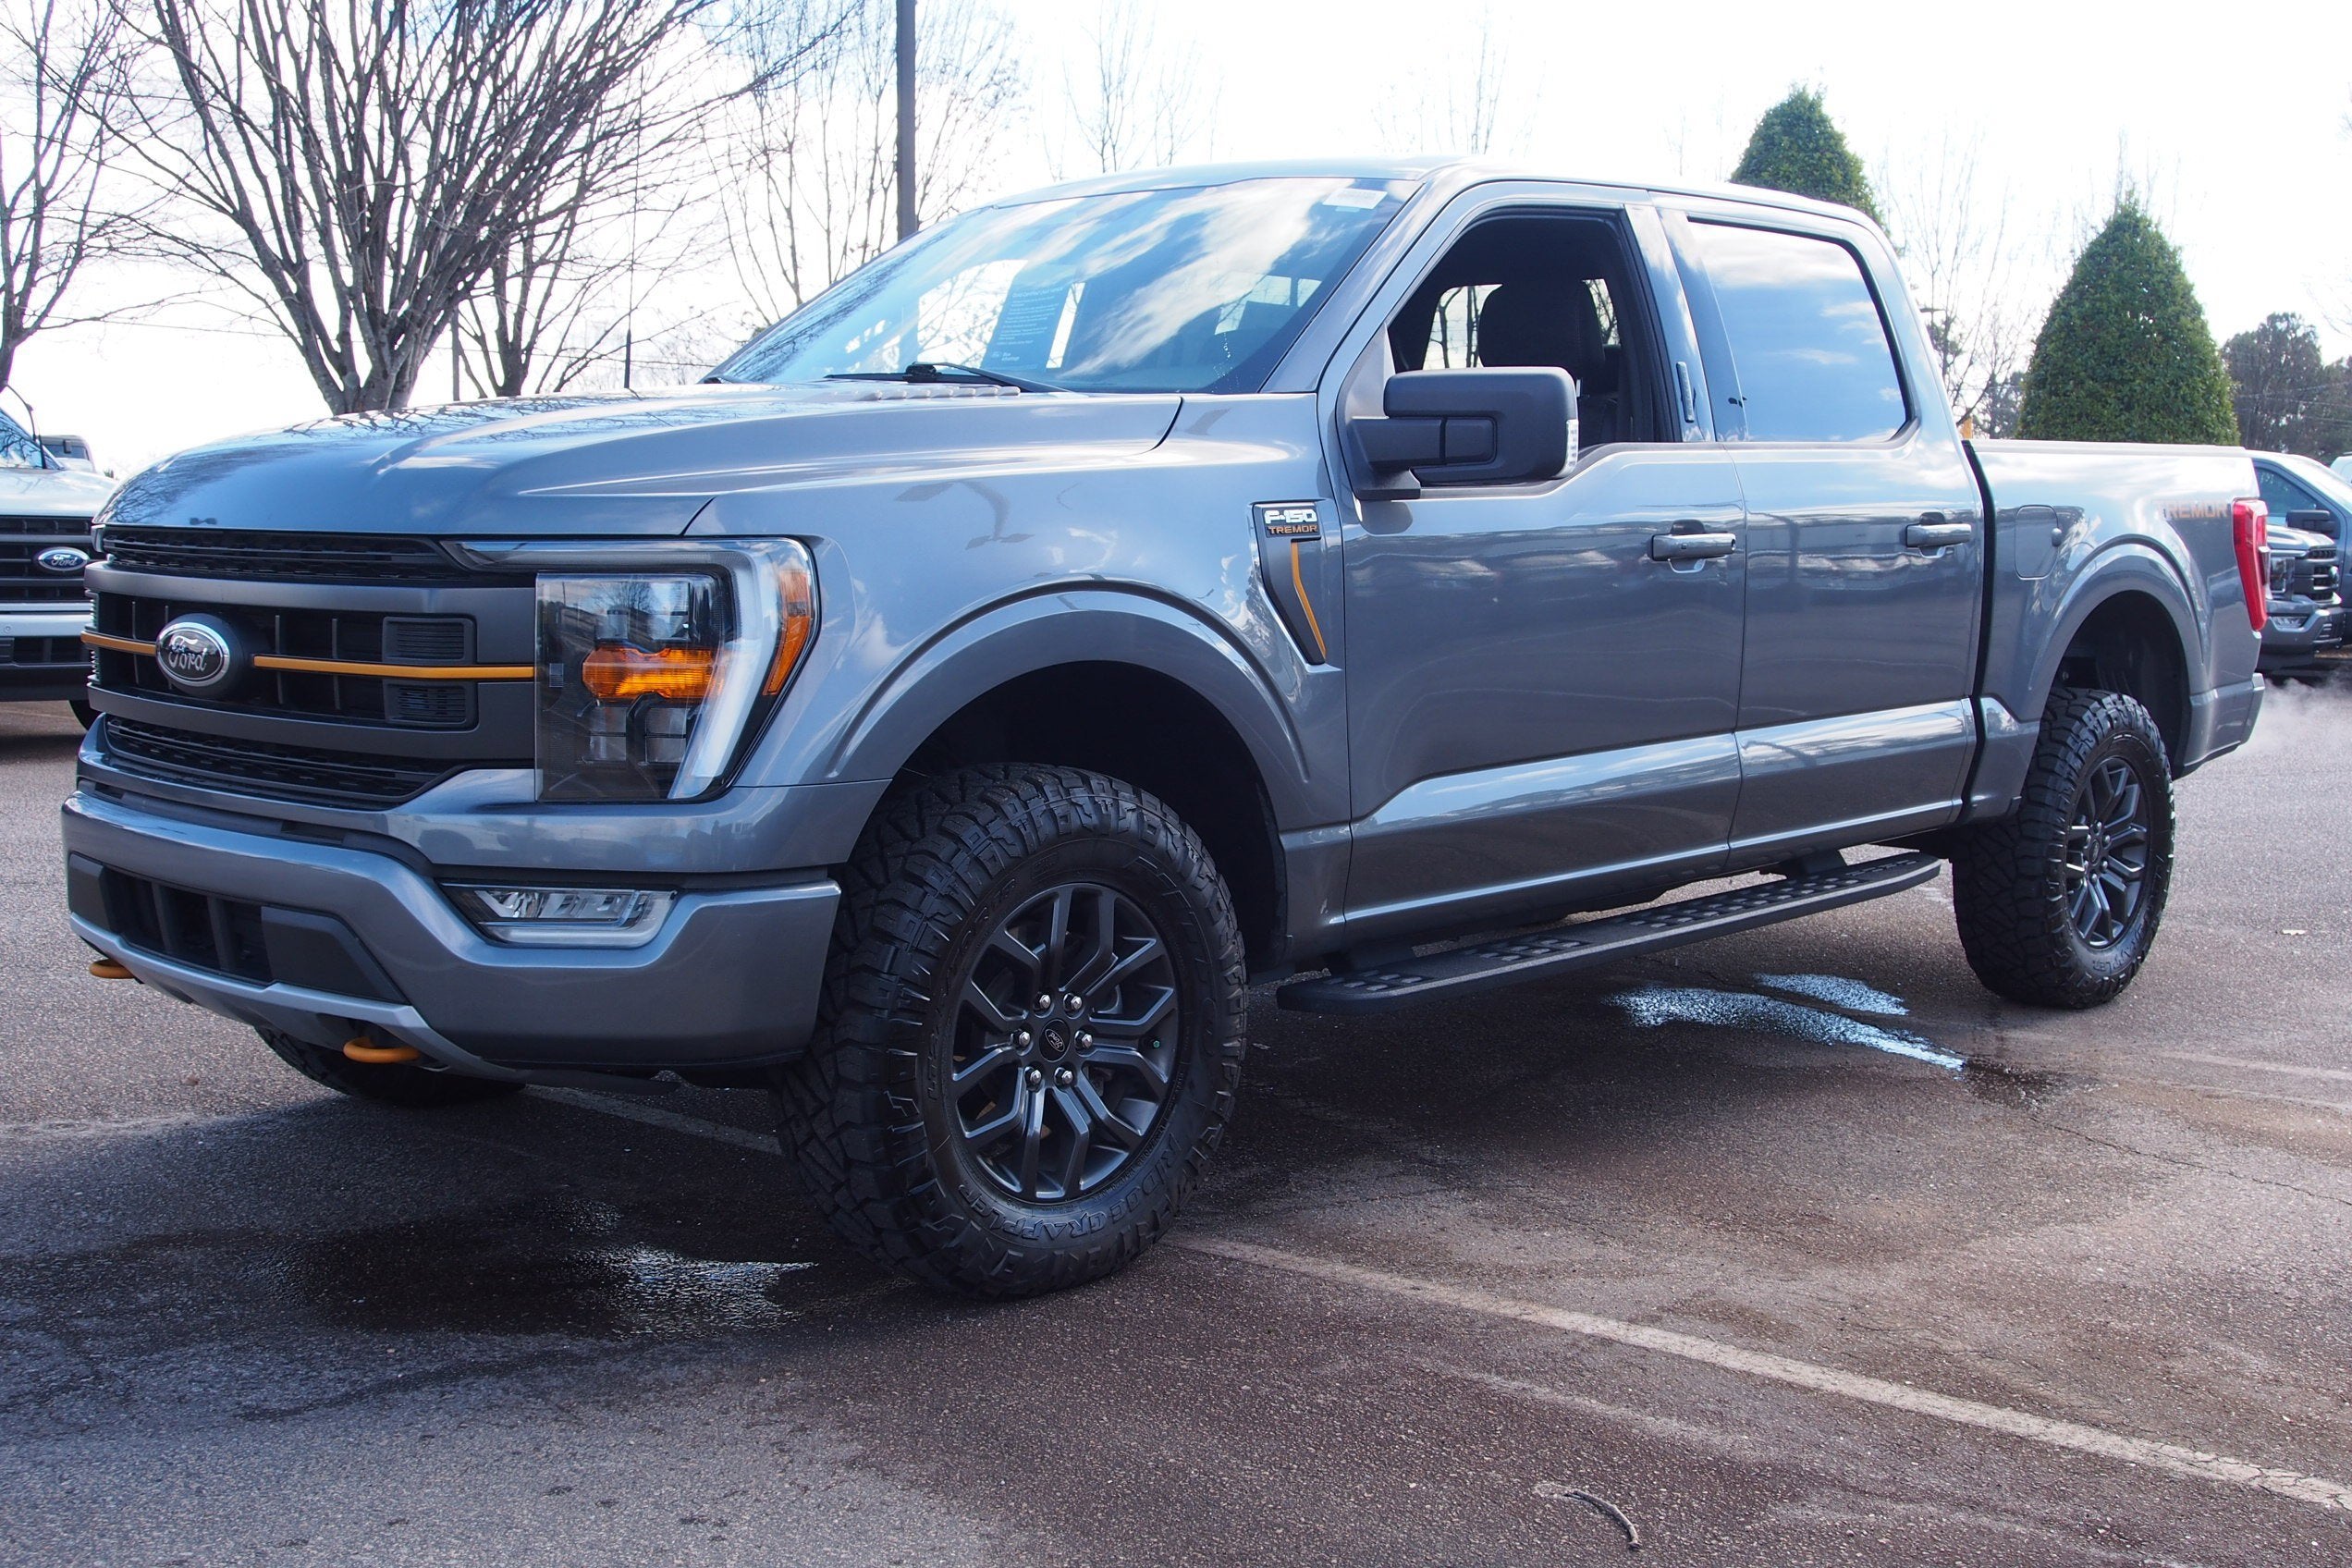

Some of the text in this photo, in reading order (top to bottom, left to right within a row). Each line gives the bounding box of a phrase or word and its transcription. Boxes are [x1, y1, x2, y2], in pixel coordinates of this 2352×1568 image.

[1264, 508, 1317, 524] F-150
[1268, 524, 1317, 534] TREMOR
[51, 554, 78, 566] Ford
[168, 634, 207, 672] Ford
[1047, 1031, 1063, 1049] Ford
[1109, 1132, 1182, 1224] RIDGE
[958, 1184, 1107, 1240] GRAPPLER
